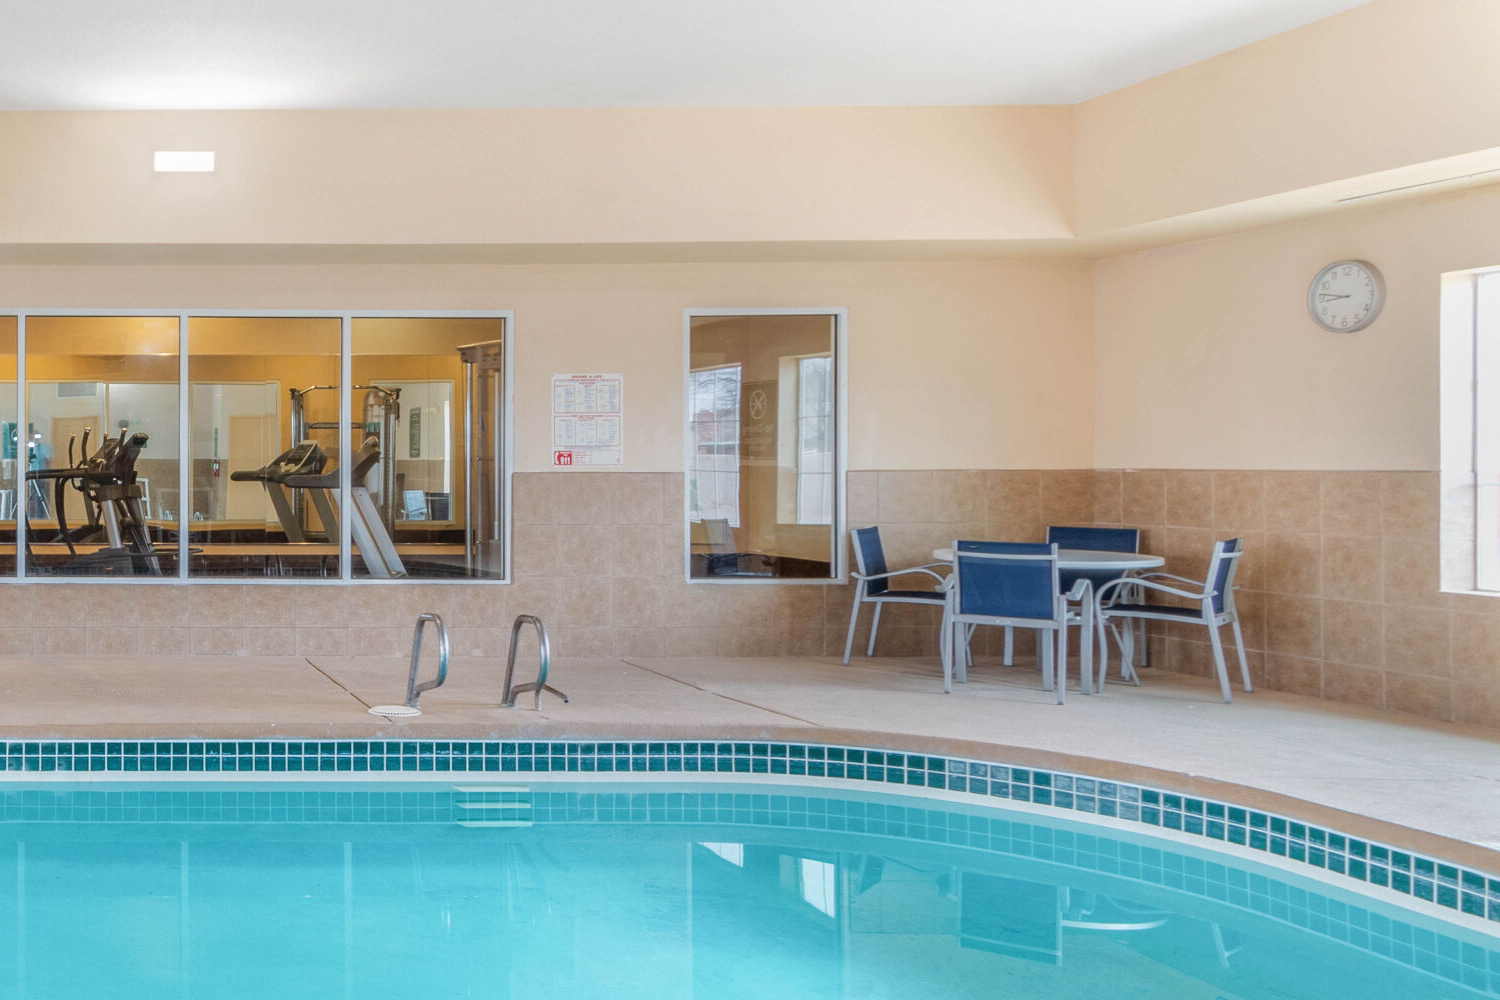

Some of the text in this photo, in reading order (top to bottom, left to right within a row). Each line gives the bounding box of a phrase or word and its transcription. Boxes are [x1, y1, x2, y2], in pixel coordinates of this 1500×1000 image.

[1331, 271, 1338, 281] 11
[1342, 266, 1353, 277] 12
[1322, 280, 1331, 291] 10
[1322, 306, 1329, 316] 8
[1341, 317, 1348, 328] 6
